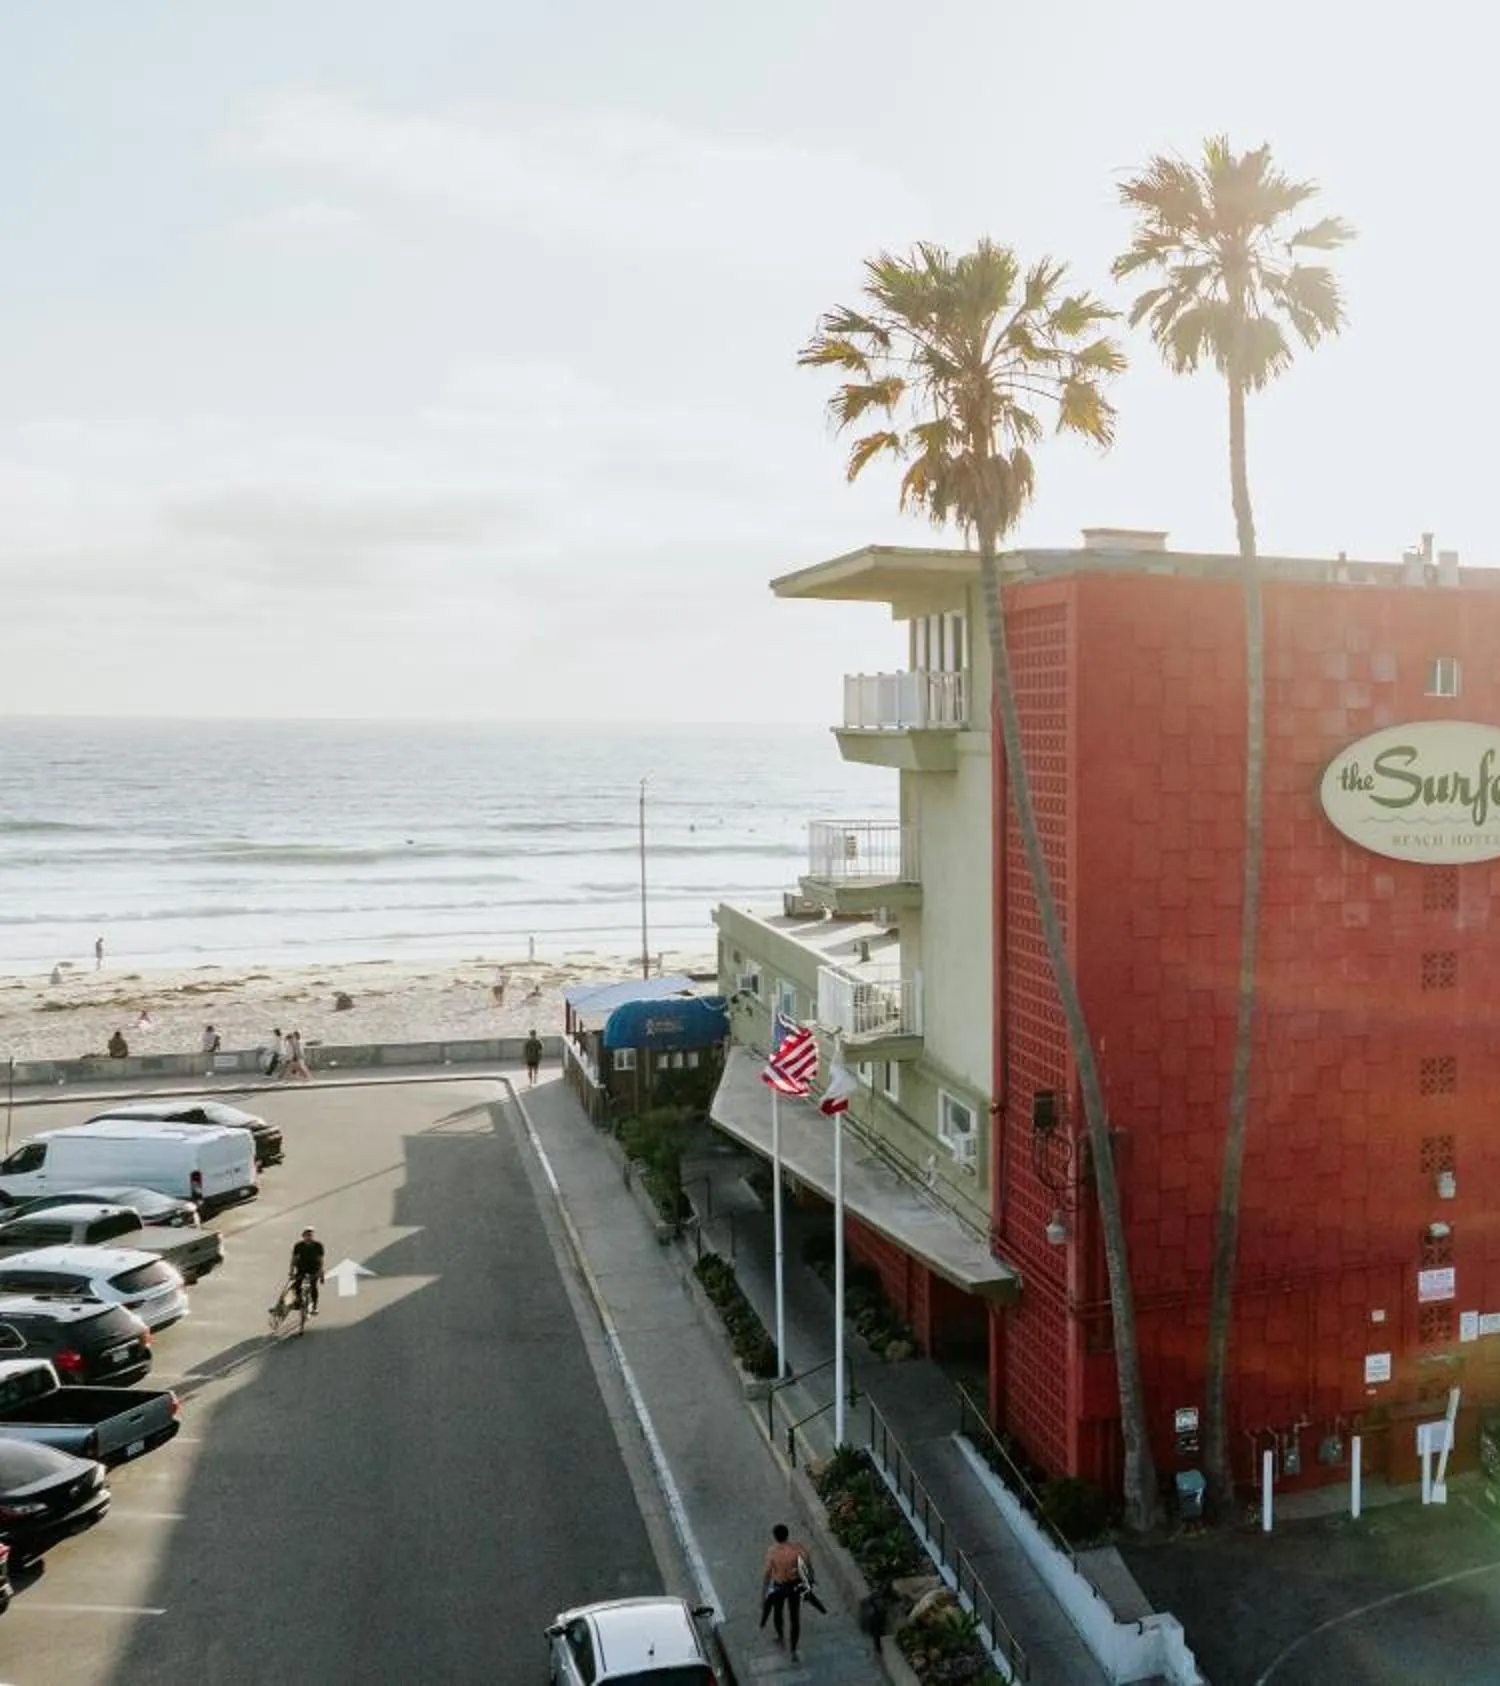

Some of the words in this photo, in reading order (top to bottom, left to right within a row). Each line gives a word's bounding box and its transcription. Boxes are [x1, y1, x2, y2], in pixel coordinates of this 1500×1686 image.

[1337, 762, 1375, 791] the
[1391, 834, 1443, 847] BEACH
[1450, 834, 1500, 847] HOTEL
